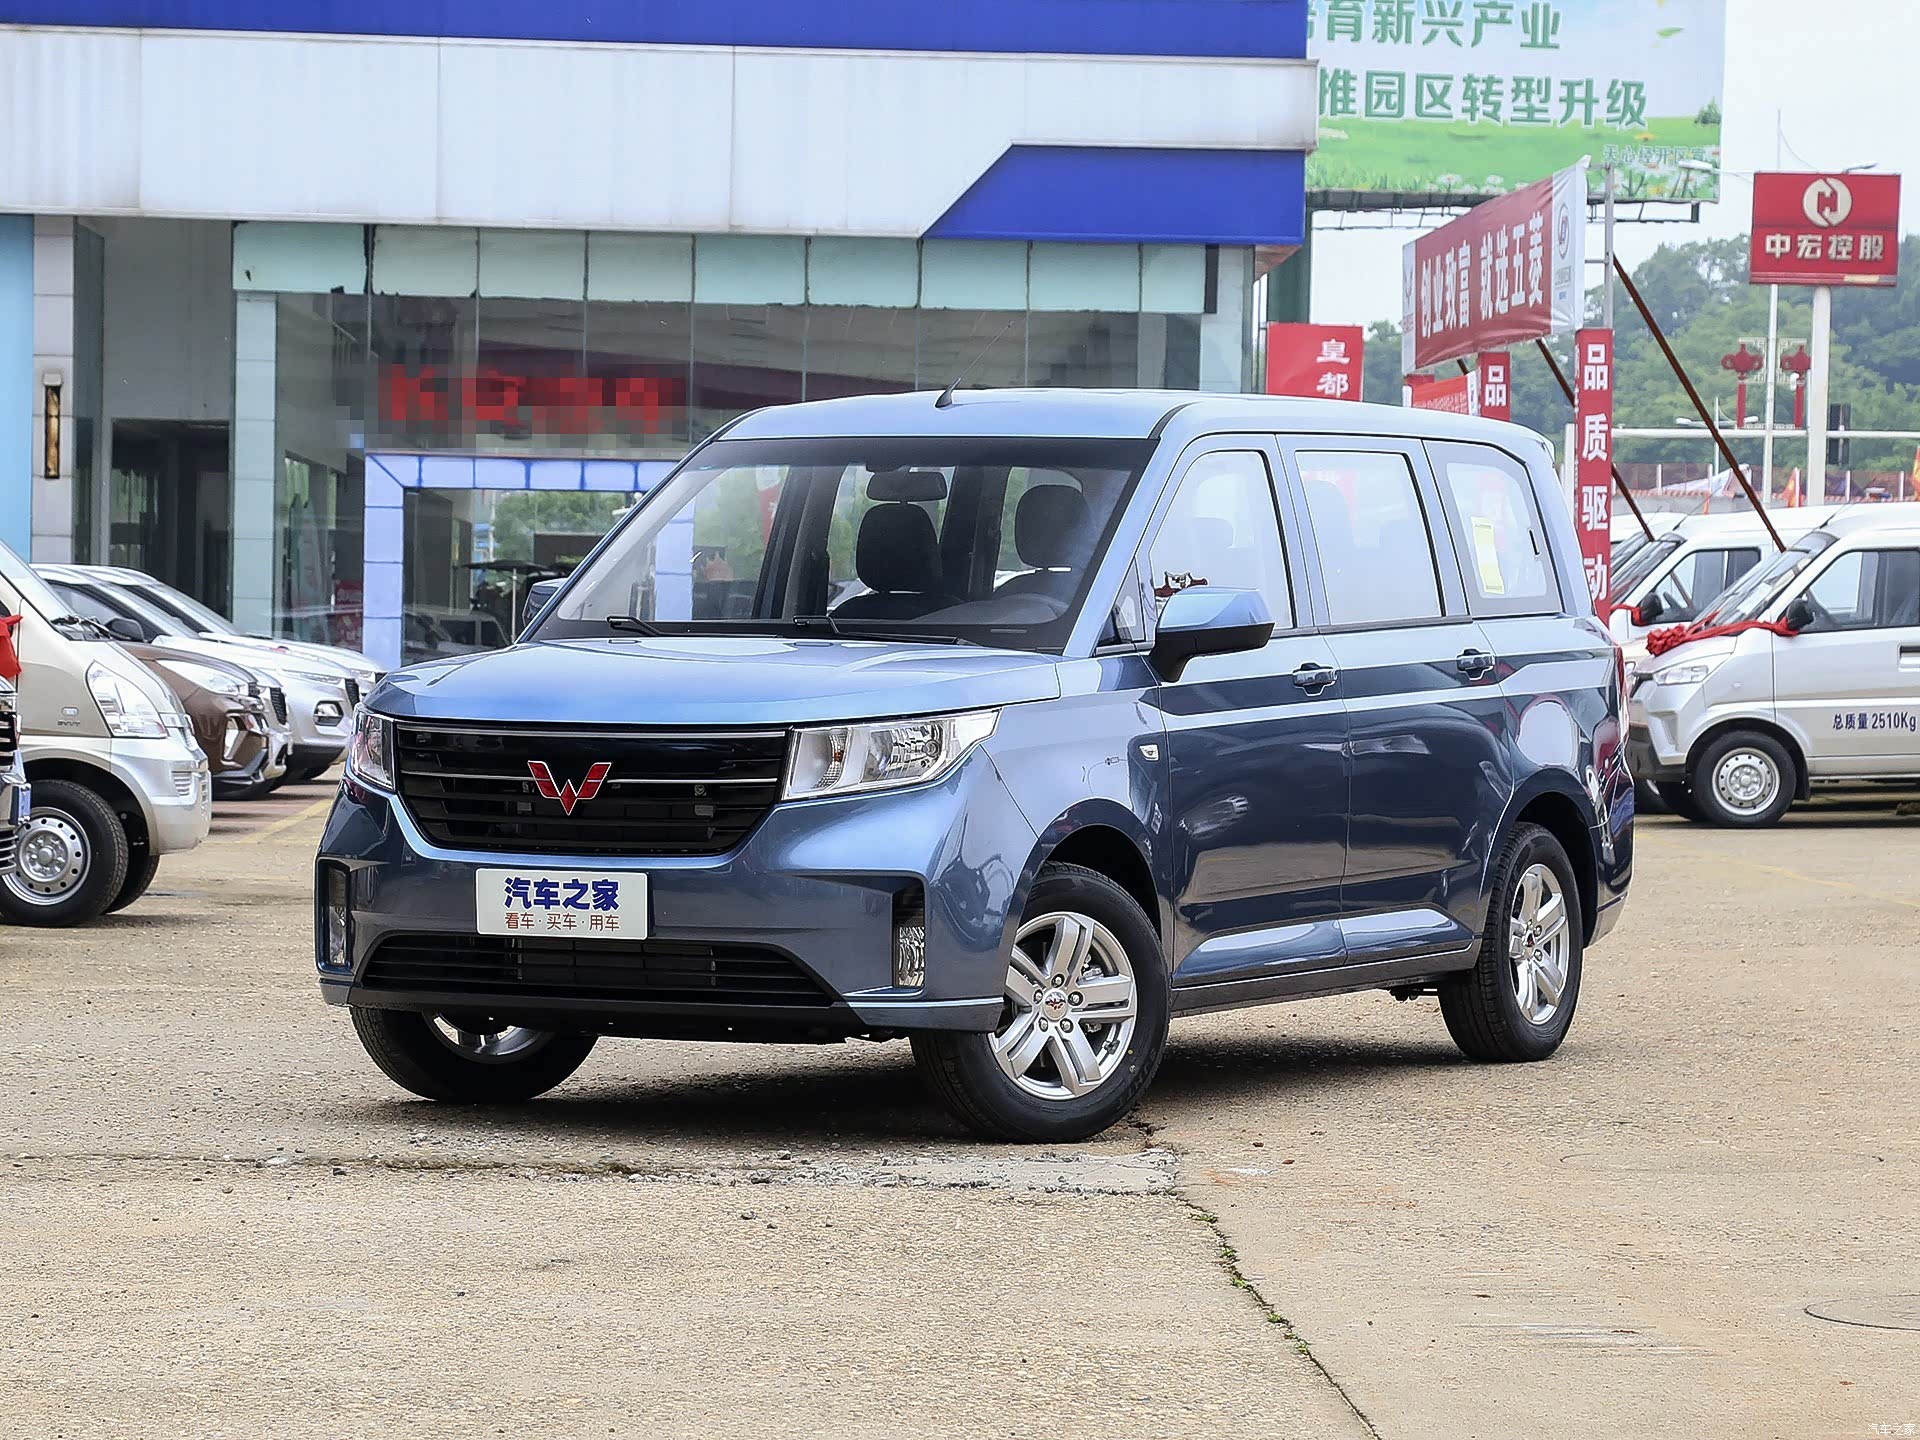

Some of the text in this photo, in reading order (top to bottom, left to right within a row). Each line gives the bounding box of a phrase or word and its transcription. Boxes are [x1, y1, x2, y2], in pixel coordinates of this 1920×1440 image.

[1308, 0, 1560, 49] 育新兴产业
[1480, 211, 1544, 321] 就选五菱
[1765, 233, 1884, 261] 中宏控股
[1316, 338, 1351, 398] 皇都
[1484, 365, 1506, 407] 品
[1582, 344, 1609, 600] 品质驱动
[1833, 711, 1917, 732] 总质量 2510Kg
[504, 877, 620, 911] 汽车之家
